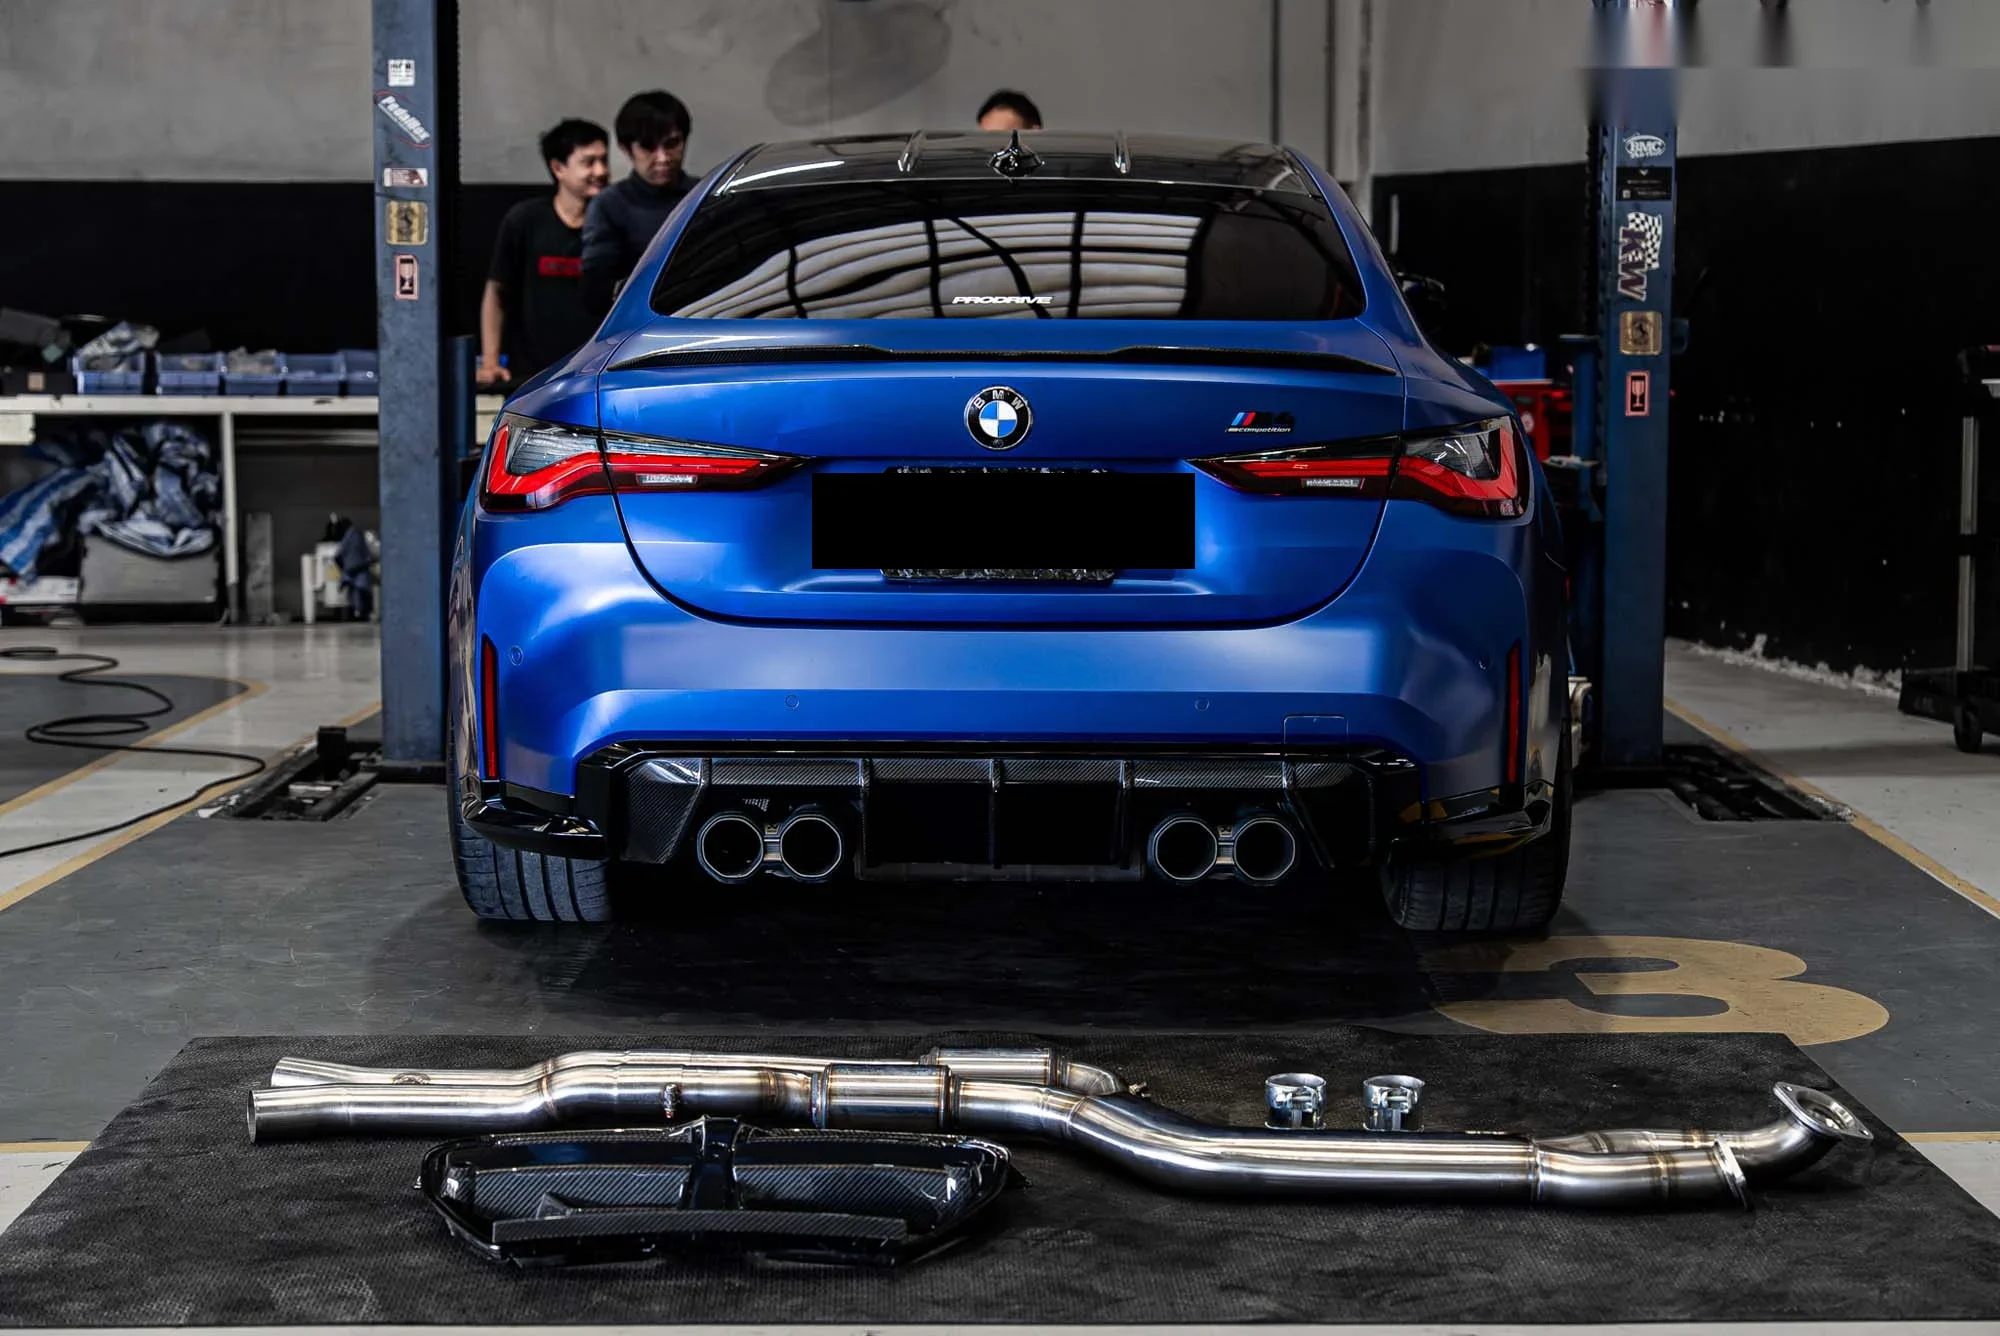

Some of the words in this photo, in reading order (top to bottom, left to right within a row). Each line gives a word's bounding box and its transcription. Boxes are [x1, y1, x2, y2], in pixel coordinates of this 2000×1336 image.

[1630, 141, 1662, 153] BMC
[1617, 226, 1648, 302] KW
[952, 296, 1053, 304] PRODRIVE
[973, 389, 1024, 410] BMW
[1432, 935, 1890, 1045] 3
